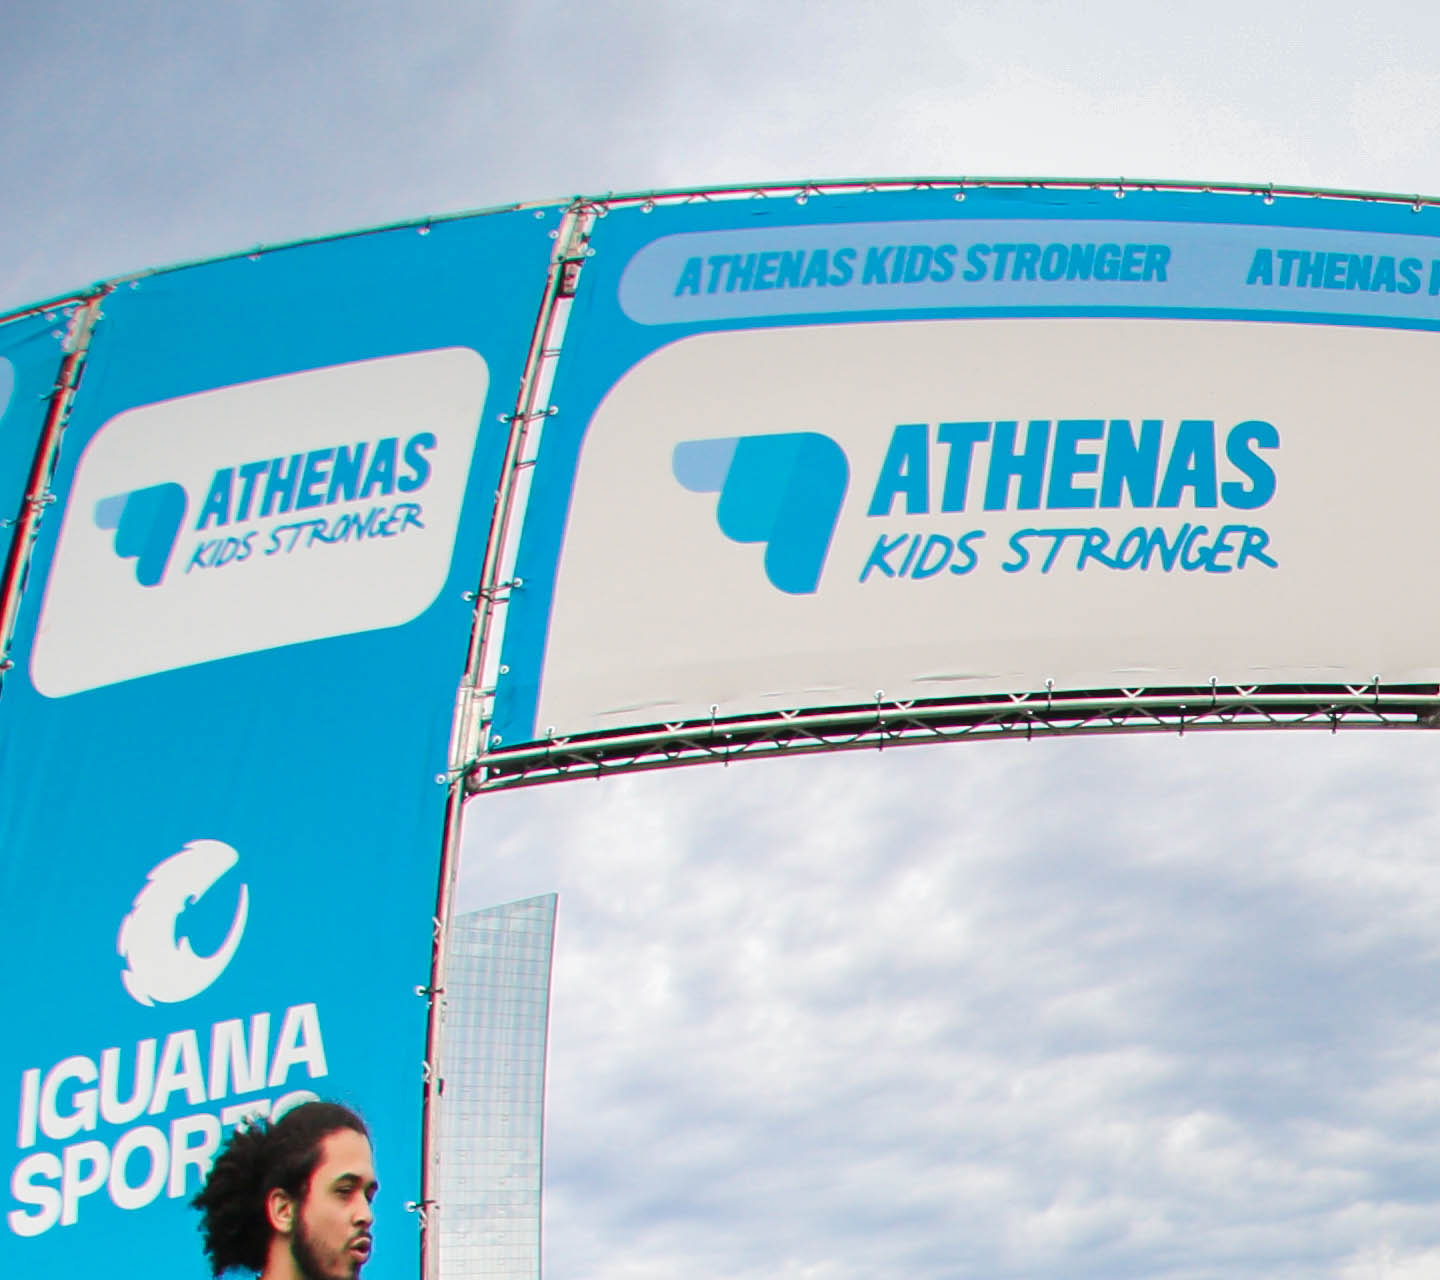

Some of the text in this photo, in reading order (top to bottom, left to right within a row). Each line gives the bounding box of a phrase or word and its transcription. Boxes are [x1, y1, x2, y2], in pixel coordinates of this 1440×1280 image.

[674, 243, 1170, 296] ATHENAS KIDS STRONGER
[1246, 248, 1422, 294] ATHENAS
[195, 433, 437, 530] ATHENAS
[868, 420, 1280, 516] ATHENAS
[186, 502, 426, 574] KIDS STRONGER
[859, 524, 1279, 582] KIDS STRONGER
[17, 1003, 328, 1149] IGUANA
